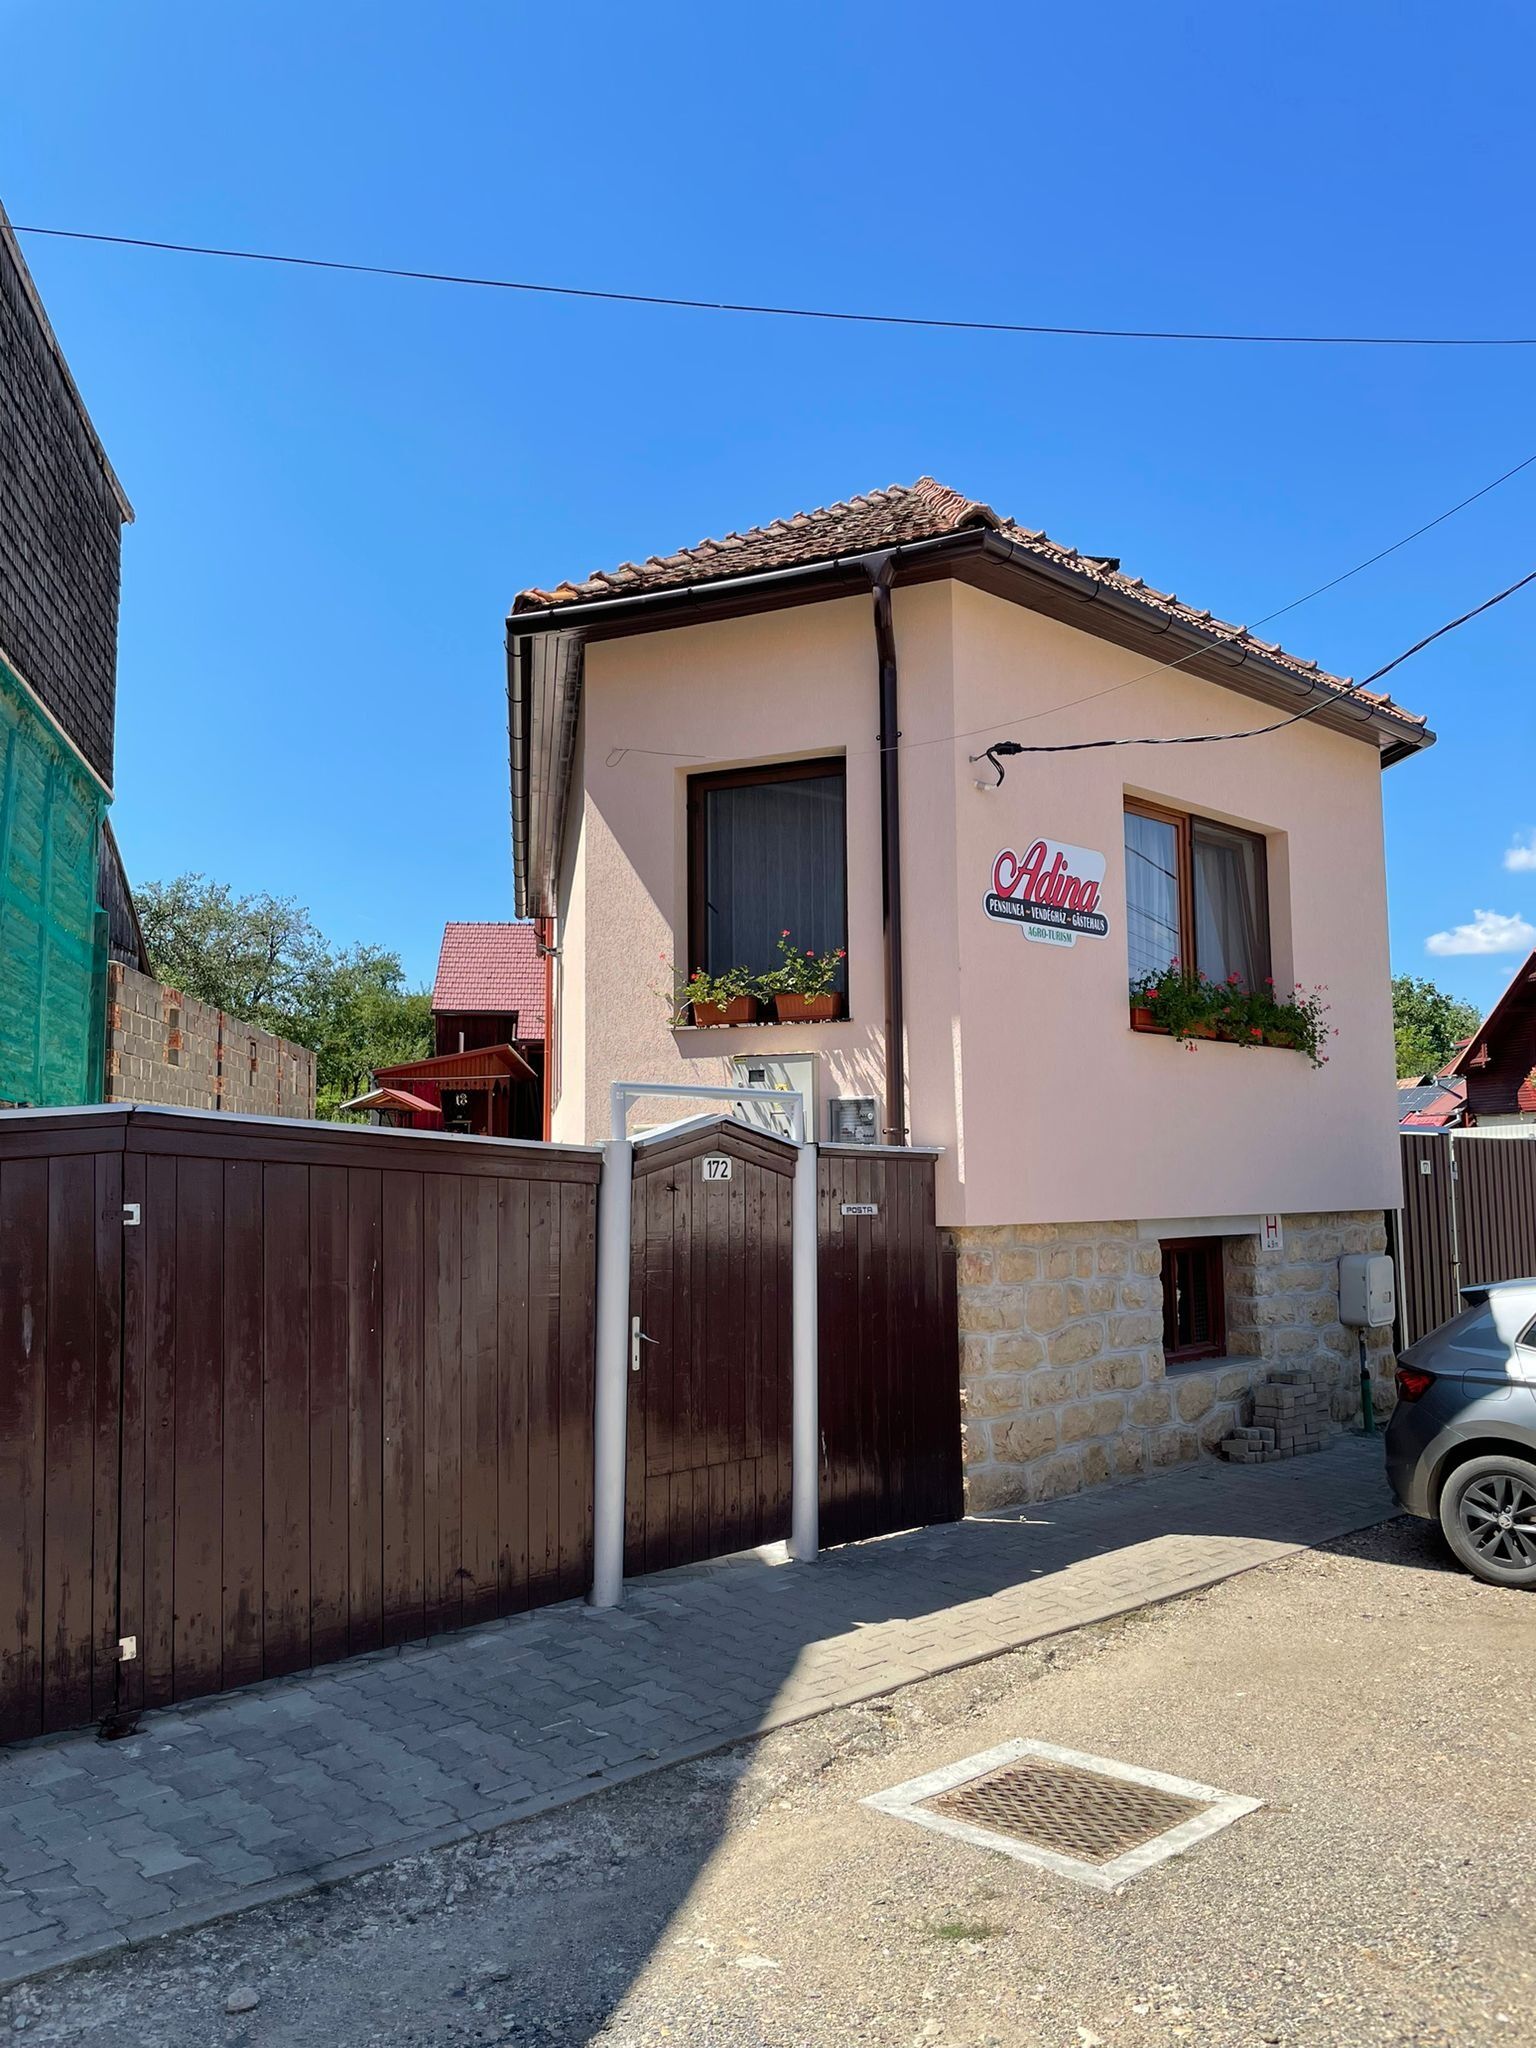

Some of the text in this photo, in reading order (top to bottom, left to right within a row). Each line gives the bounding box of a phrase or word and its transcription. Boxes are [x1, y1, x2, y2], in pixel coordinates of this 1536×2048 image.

[994, 841, 1101, 913] Adina
[989, 898, 1105, 932] PENSIUNEA VENDÉGHÁZ GÄSTEHAUS
[1028, 926, 1073, 943] AGRO-TURISM
[706, 1160, 729, 1179] 172
[845, 1206, 874, 1214] POSTA
[1266, 1216, 1278, 1239] H
